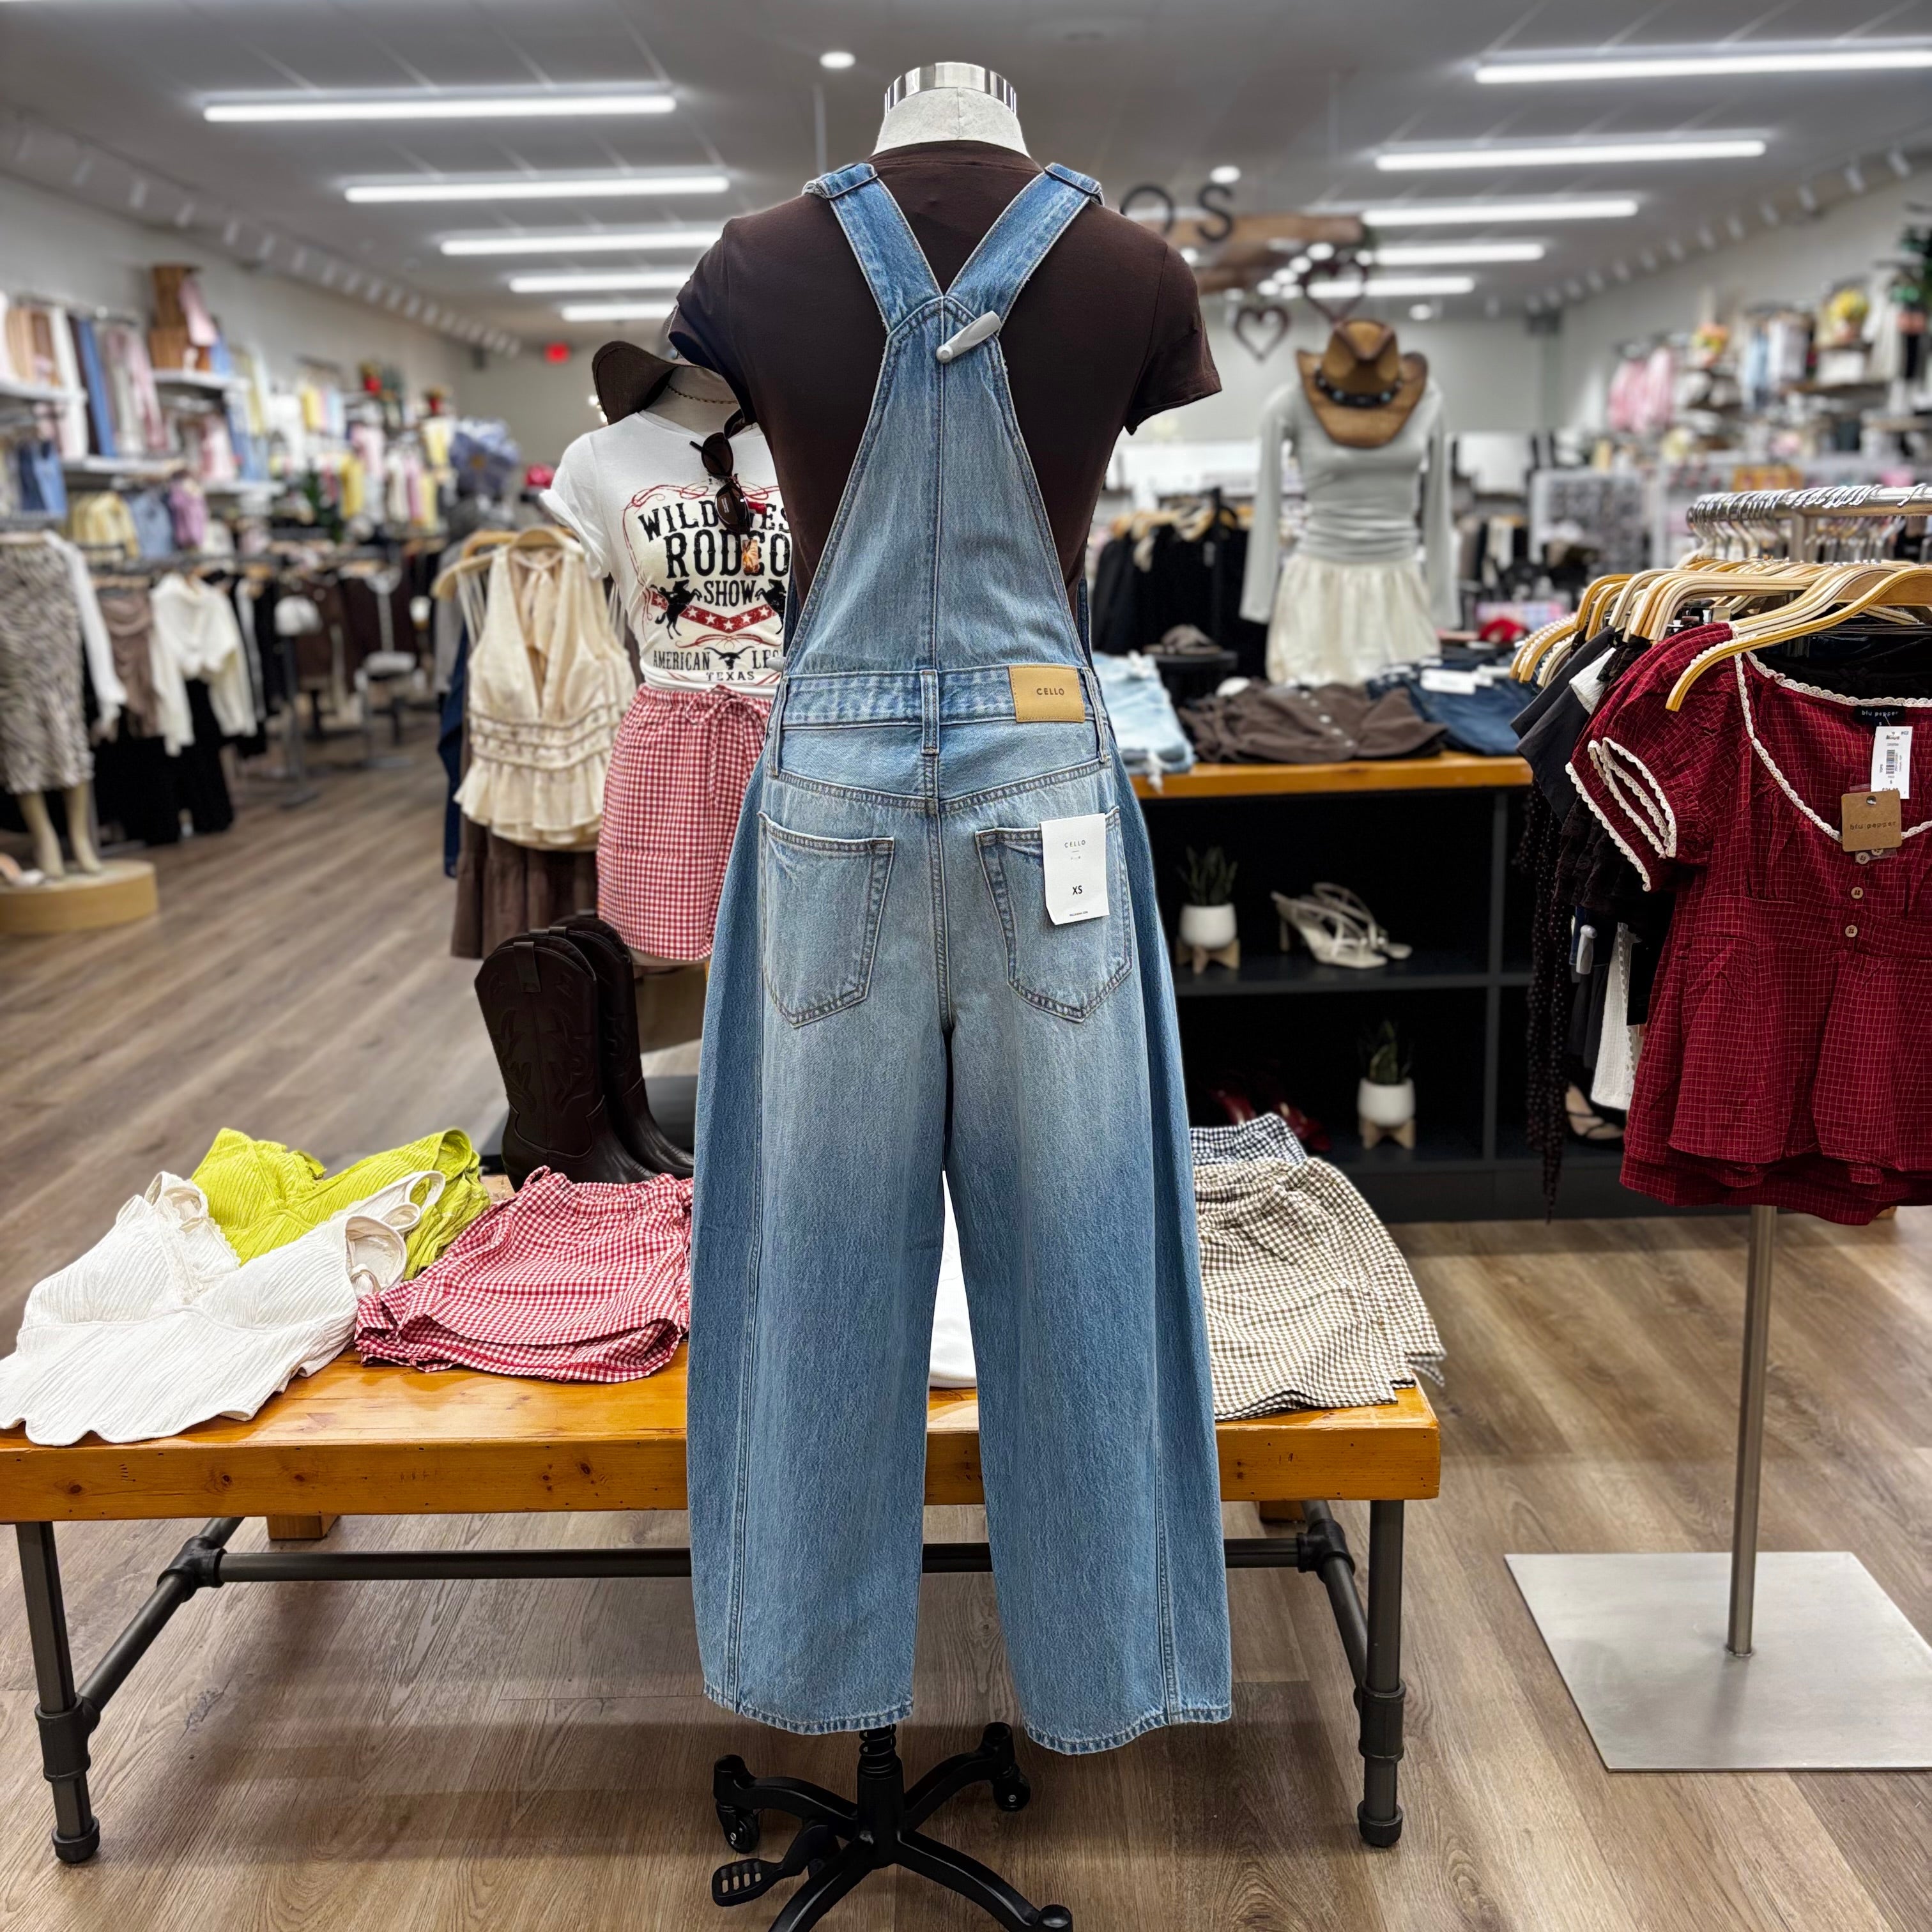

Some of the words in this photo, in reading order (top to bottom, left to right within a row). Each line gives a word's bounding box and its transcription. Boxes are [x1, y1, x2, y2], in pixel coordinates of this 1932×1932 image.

[638, 500, 719, 542] WILD
[663, 528, 790, 579] RODEO
[703, 579, 756, 607] SHOW
[652, 649, 710, 671] AMERICAN
[705, 671, 755, 682] TEXAS
[1036, 687, 1065, 696] CELLO
[1850, 820, 1864, 830] blu
[1064, 839, 1086, 848] CELLO
[1072, 885, 1083, 895] XS
